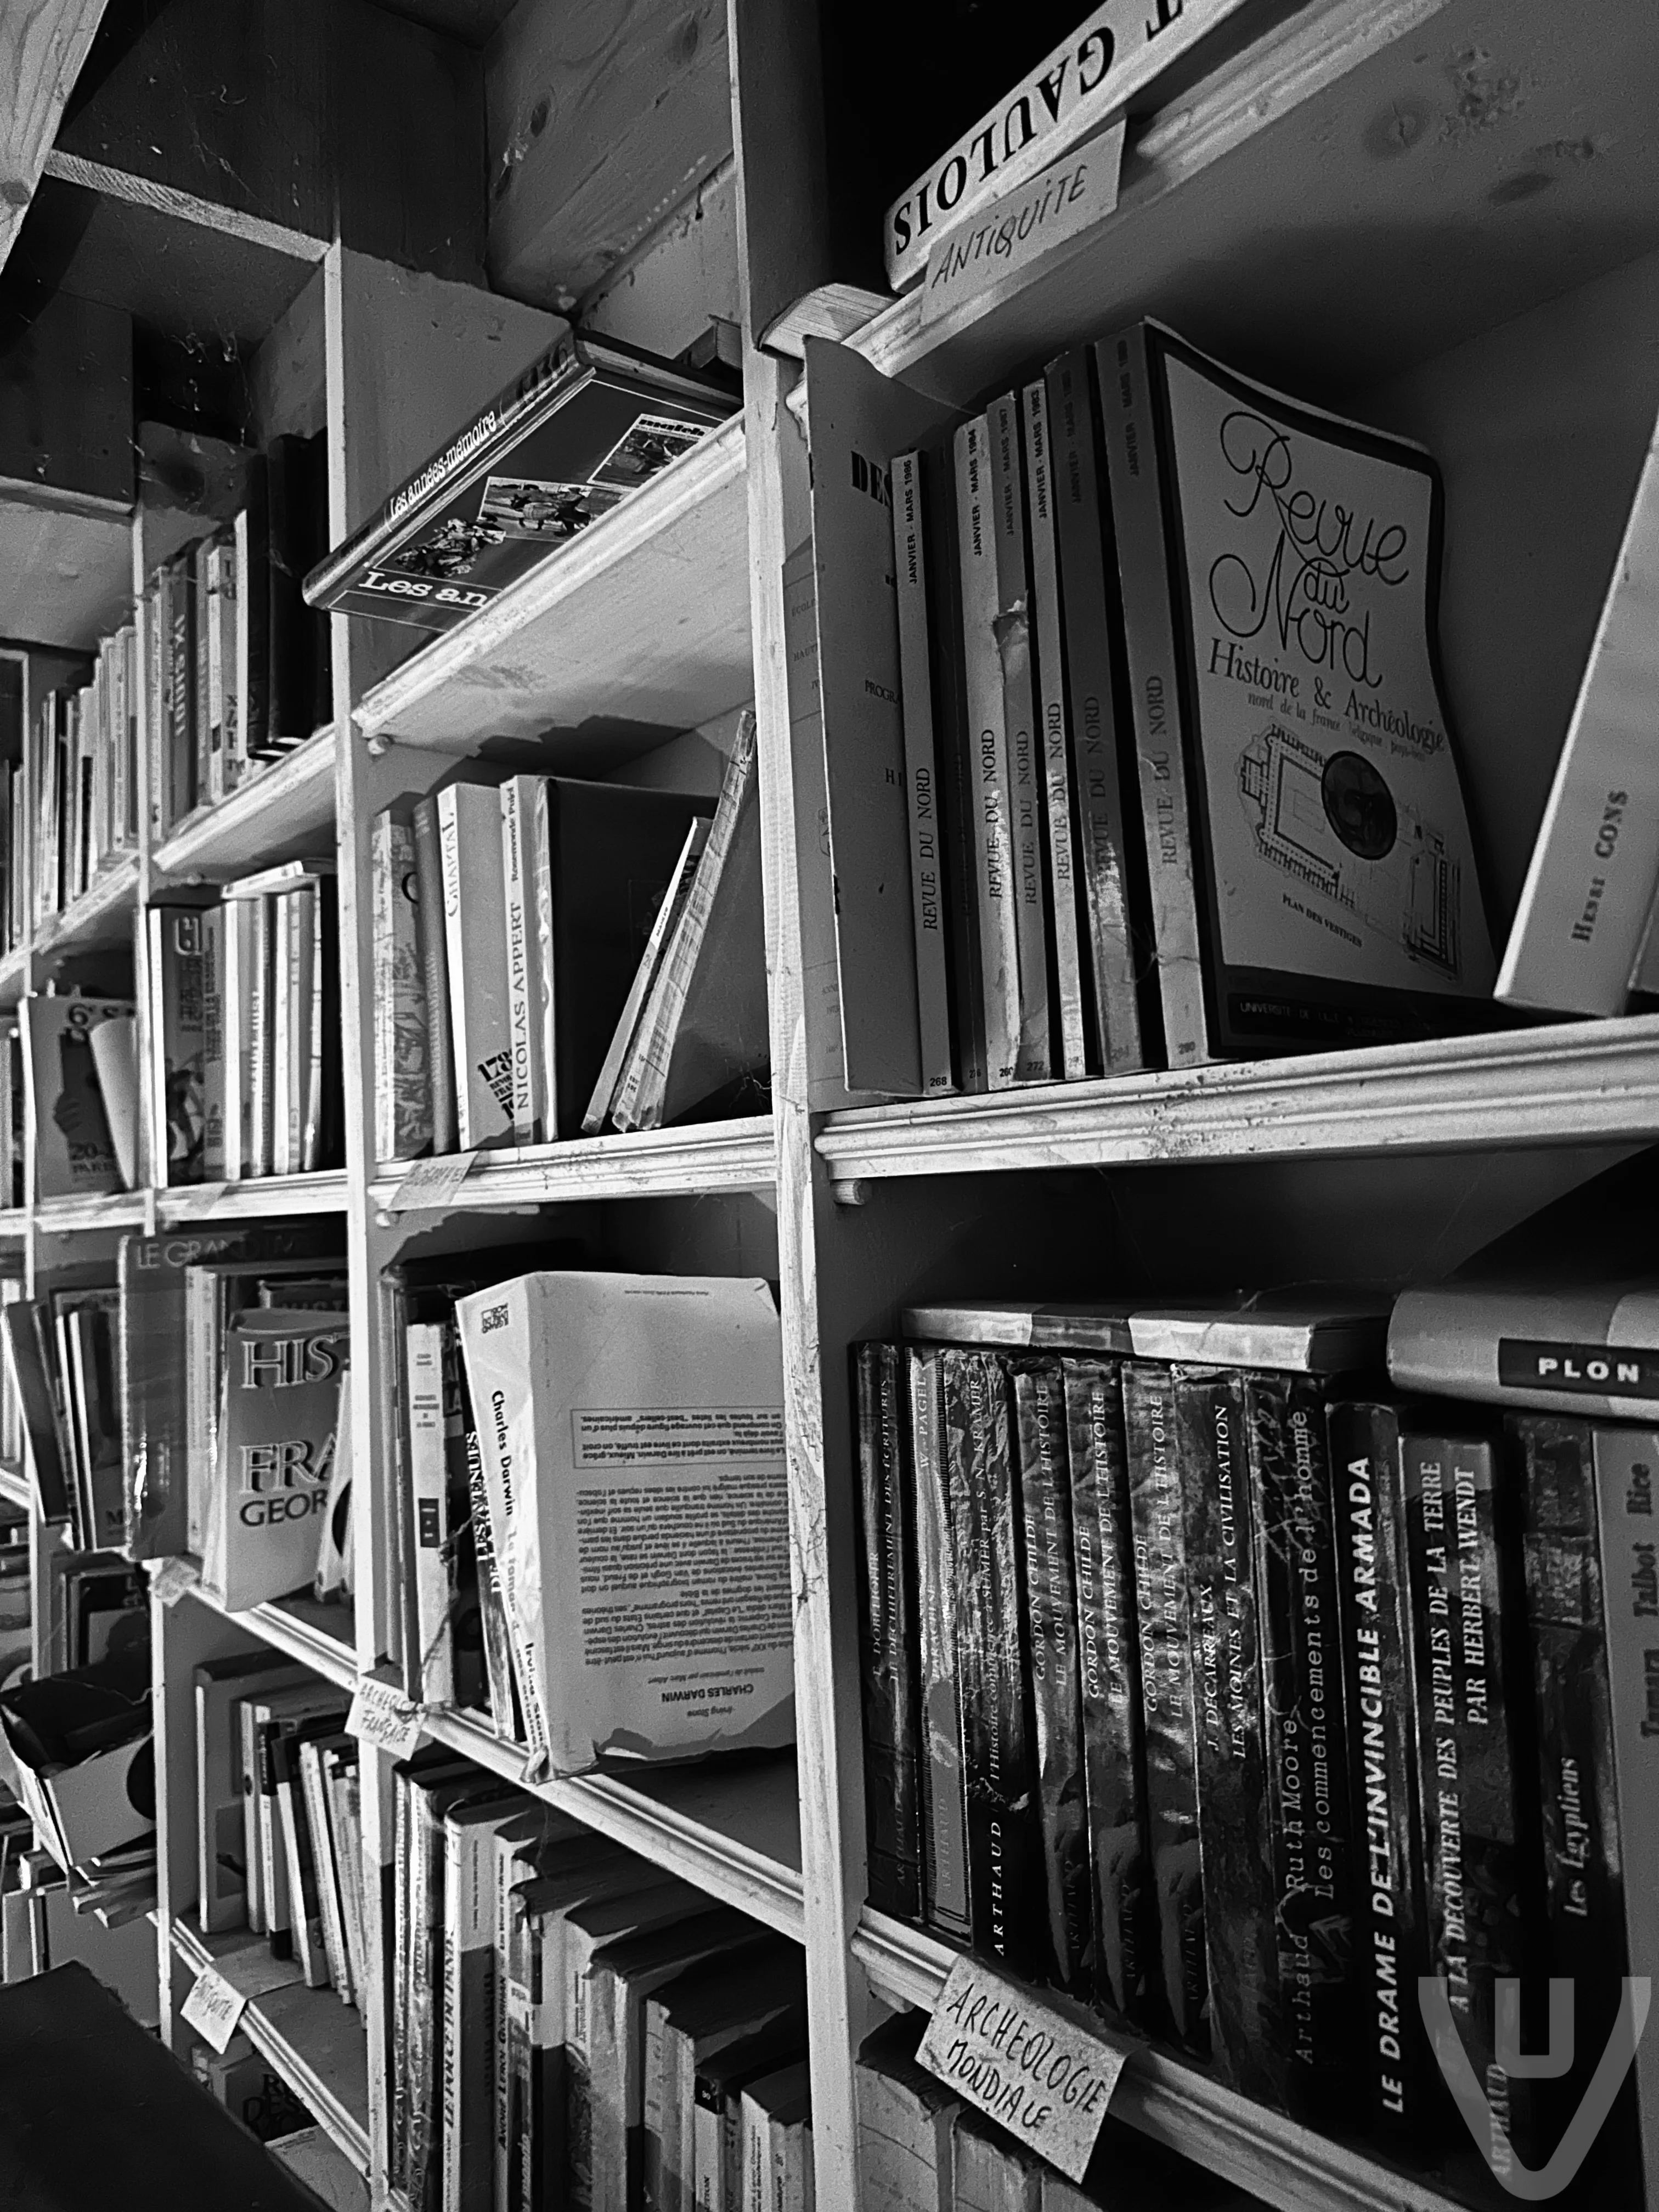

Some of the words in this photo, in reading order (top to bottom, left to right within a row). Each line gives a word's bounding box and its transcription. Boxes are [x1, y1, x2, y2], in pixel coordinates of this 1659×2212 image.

[893, 27, 1114, 255] GAULOIS
[390, 487, 408, 519] Les
[405, 410, 497, 507] années-mémoire
[967, 428, 978, 455] 1984
[1002, 439, 1012, 477] MARS
[1034, 421, 1045, 459] MARS
[903, 459, 912, 486] 1986
[969, 456, 979, 495] MARS
[1036, 467, 1048, 520] JANVIER
[1221, 411, 1409, 585] Revue
[905, 488, 915, 522] MARS
[972, 505, 983, 557] JANVIER
[1004, 483, 1015, 537] JANVIER
[359, 572, 433, 598] Les
[905, 534, 918, 585] JANVIER
[1304, 562, 1350, 613] du
[1209, 529, 1382, 688] Nord
[1085, 695, 1102, 755] NORD
[1144, 674, 1167, 736] NORD
[1207, 637, 1300, 698] Histoire
[1314, 676, 1331, 709] &
[1345, 689, 1443, 755] Archéologie
[980, 728, 997, 783] NORD
[1015, 730, 1030, 786] NORD
[1047, 702, 1064, 760] NORD
[915, 767, 933, 820] NORD
[1050, 772, 1066, 803] DU
[1089, 770, 1106, 799] DU
[1153, 749, 1171, 782] DU
[985, 795, 1000, 825] DU
[1020, 798, 1034, 828] DU
[1156, 794, 1178, 865] REVUE
[1595, 788, 1629, 859] CONS
[919, 831, 934, 860] DU
[988, 837, 1003, 900] REVUE
[1024, 841, 1037, 906] REVUE
[1053, 816, 1070, 880] REVUE
[923, 871, 939, 931] REVUE
[1282, 894, 1304, 915] PLAN
[1306, 905, 1323, 925] DES
[1323, 915, 1363, 947] VESTIGES
[511, 902, 524, 993] APPERT
[515, 999, 529, 1110] NICOLAS
[929, 1076, 948, 1088] 268
[1026, 1061, 1044, 1073] 272
[136, 1242, 161, 1270] LE
[1538, 1357, 1640, 1383] PLON
[492, 1390, 509, 1451] Charles
[917, 1377, 928, 1435] PAGEL
[970, 1379, 984, 1454] KRAMER
[1037, 1385, 1053, 1489] L'HISTOIRE
[1092, 1391, 1110, 1500] L'HISTOIRE
[1151, 1394, 1170, 1506] L'HISTOIRE
[500, 1453, 515, 1517] Darwin
[1214, 1404, 1236, 1547] CIVILISATION
[1291, 1410, 1315, 1533] l'homme
[1419, 1461, 1444, 1533] TERRE
[976, 1506, 991, 1533] par
[1045, 1494, 1057, 1522] DE
[1099, 1505, 1113, 1534] DE
[1158, 1513, 1172, 1542] DE
[1347, 1457, 1379, 1611] ARMADA
[1453, 1466, 1479, 1550] WENDT
[979, 1539, 993, 1598] SUMER
[1025, 1513, 1040, 1587] CHILDE
[1079, 1525, 1094, 1600] CHILDE
[1136, 1533, 1152, 1611] CHILDE
[1223, 1558, 1237, 1583] LA
[1297, 1548, 1318, 1584] de
[1425, 1546, 1447, 1575] LA
[1046, 1525, 1066, 1657] MOUVEMENT
[1100, 1538, 1122, 1674] MOUVEMENT
[1161, 1551, 1182, 1687] MOUVEMENT
[1226, 1593, 1240, 1620] ET
[1427, 1587, 1449, 1616] DE
[1459, 1557, 1486, 1667] HERBERT
[1030, 1594, 1046, 1681] GORDON
[1083, 1609, 1099, 1699] GORDON
[1199, 1584, 1220, 1727] DECARREAUX
[661, 1688, 705, 1703] DARWIN
[707, 1683, 754, 1698] CHARLES
[1056, 1662, 1067, 1686] LE
[1141, 1623, 1158, 1712] GORDON
[1227, 1628, 1245, 1714] MOINES
[1430, 1627, 1455, 1727] PEUPLES
[1170, 1692, 1183, 1719] LE
[1304, 1594, 1331, 1836] commencements
[1466, 1677, 1488, 1726] PAR
[1231, 1725, 1246, 1759] LES
[1280, 1718, 1300, 1812] Moore
[1356, 1627, 1392, 1860] L'INVINCIBLE
[1435, 1736, 1458, 1780] DES
[1283, 1819, 1307, 1891] Ruth
[1314, 1849, 1335, 1901] Les
[990, 1821, 1005, 1956] ARTHAUD
[1371, 1869, 1394, 1917] DE
[1374, 1931, 1401, 2062] DRAME
[1449, 1954, 1469, 1986] LA
[1293, 1934, 1313, 2066] Arthaud
[1449, 1994, 1469, 2013] A
[947, 1984, 1107, 2114] ARCHEOLOGIE
[947, 2039, 1051, 2130] MONDIALE
[1380, 2074, 1404, 2114] LE
